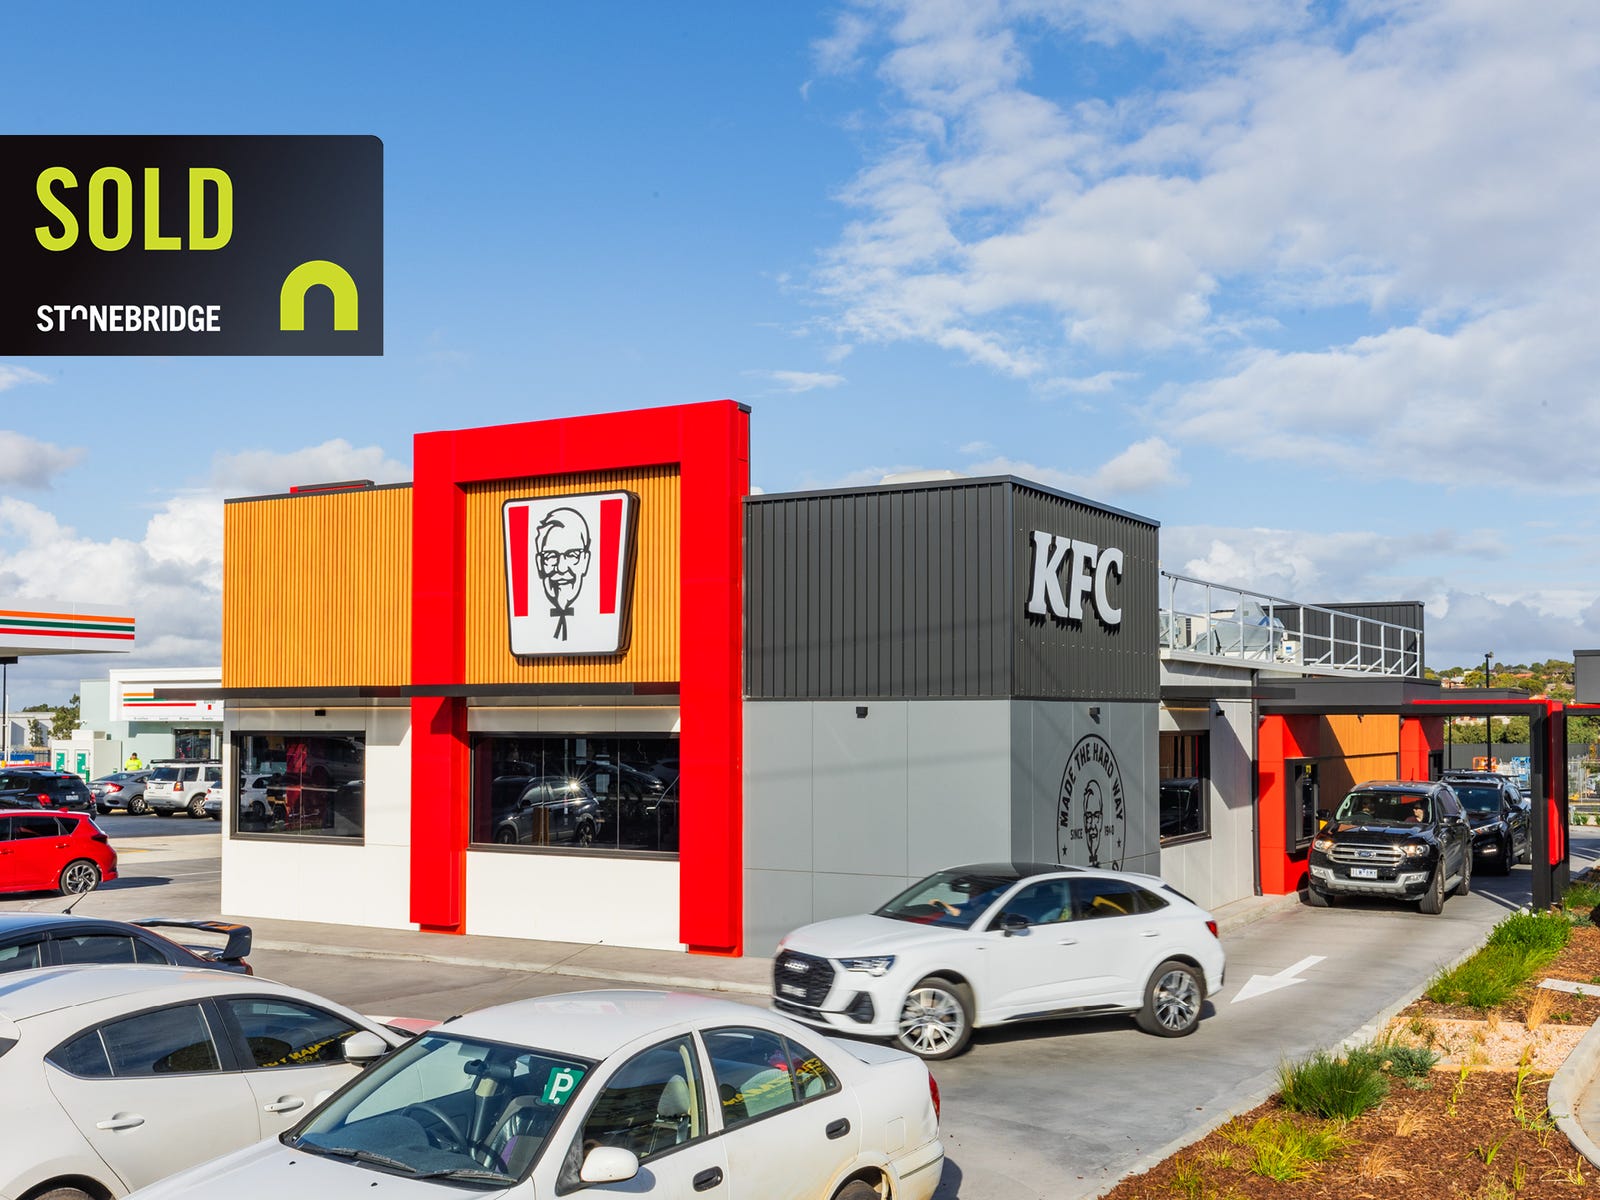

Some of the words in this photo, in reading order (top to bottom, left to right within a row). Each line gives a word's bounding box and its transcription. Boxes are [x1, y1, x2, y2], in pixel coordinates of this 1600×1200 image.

[1028, 530, 1124, 625] KFC
[1060, 767, 1076, 828] MADE
[1074, 743, 1091, 772] THE
[1093, 743, 1114, 779] HARD
[1112, 778, 1124, 820] WAY
[1070, 828, 1083, 841] SINCE
